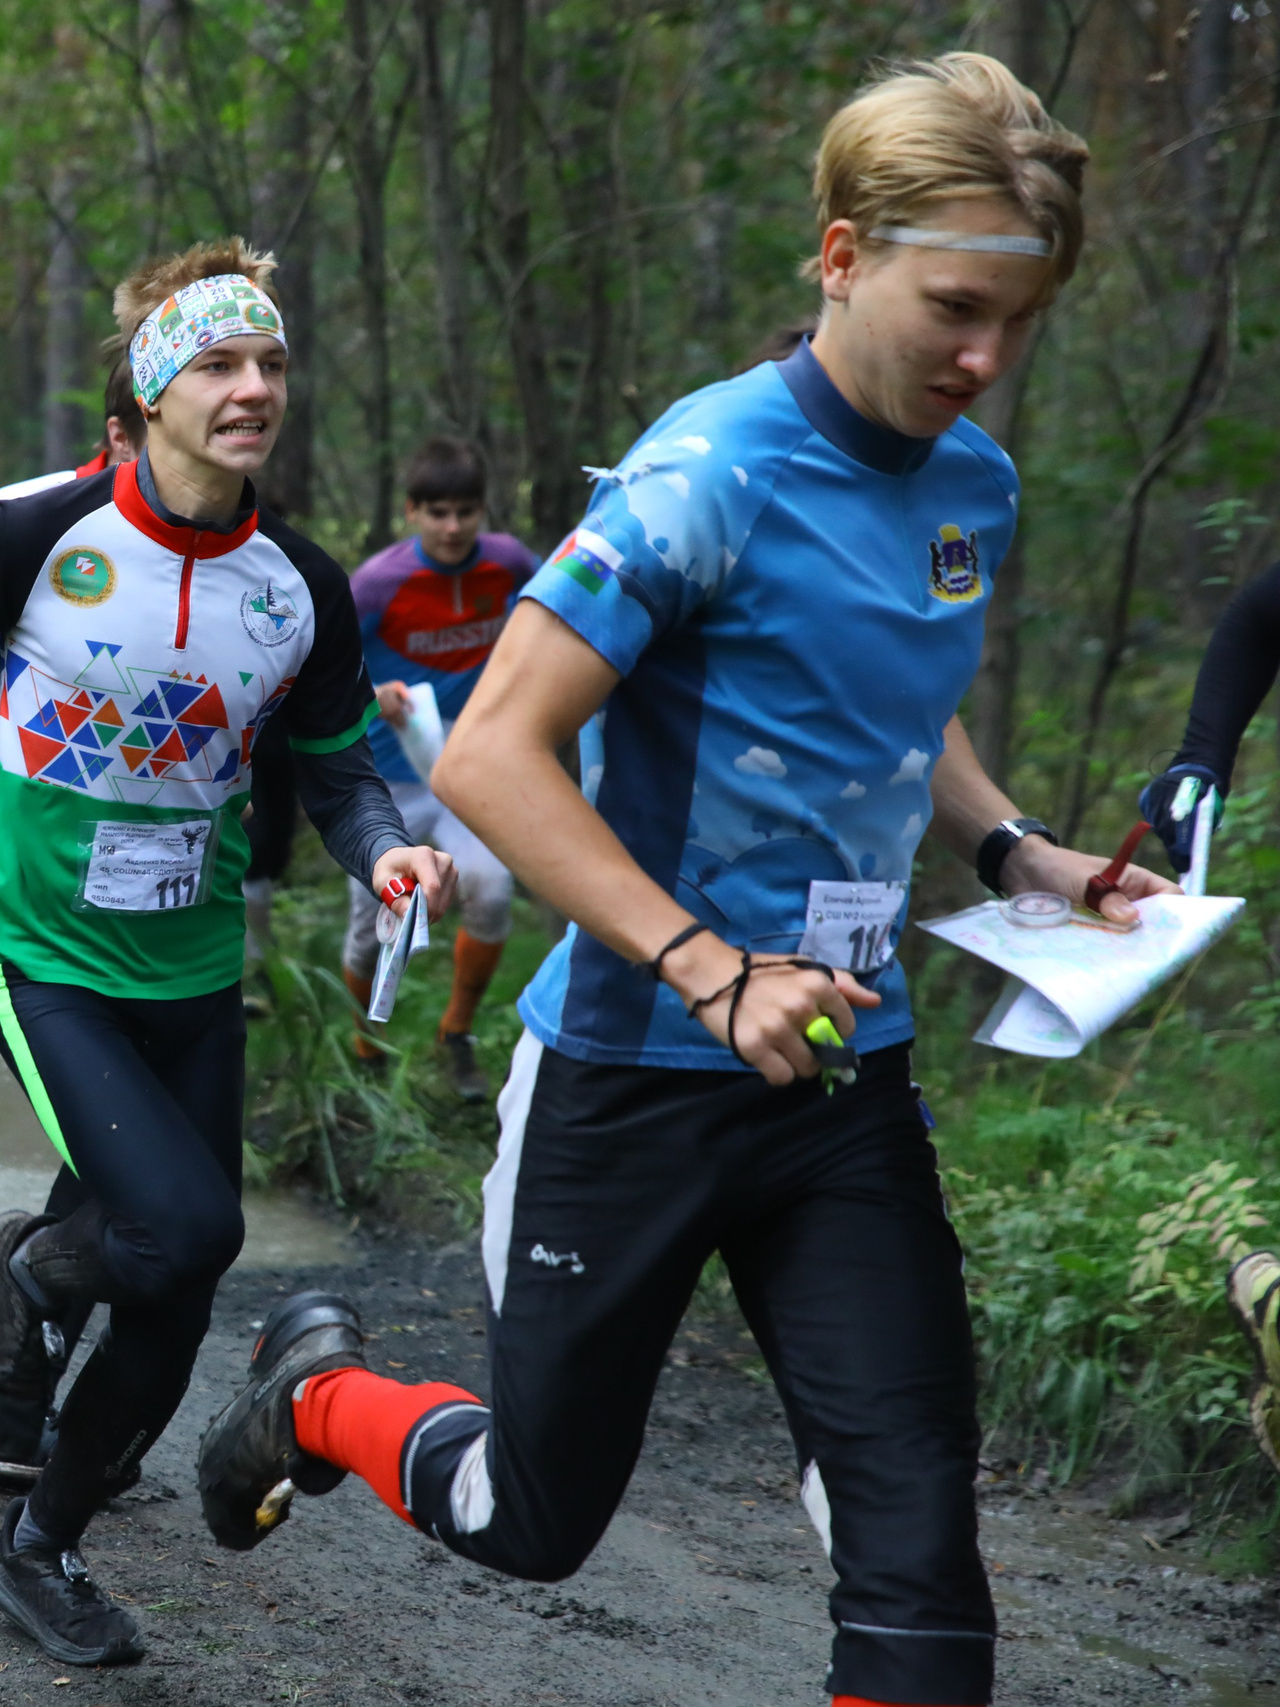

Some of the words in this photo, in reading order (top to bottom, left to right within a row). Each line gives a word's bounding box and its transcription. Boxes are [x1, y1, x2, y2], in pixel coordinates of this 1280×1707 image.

[156, 873, 195, 908] 111
[849, 925, 880, 968] 11
[118, 1429, 147, 1468] NORD
